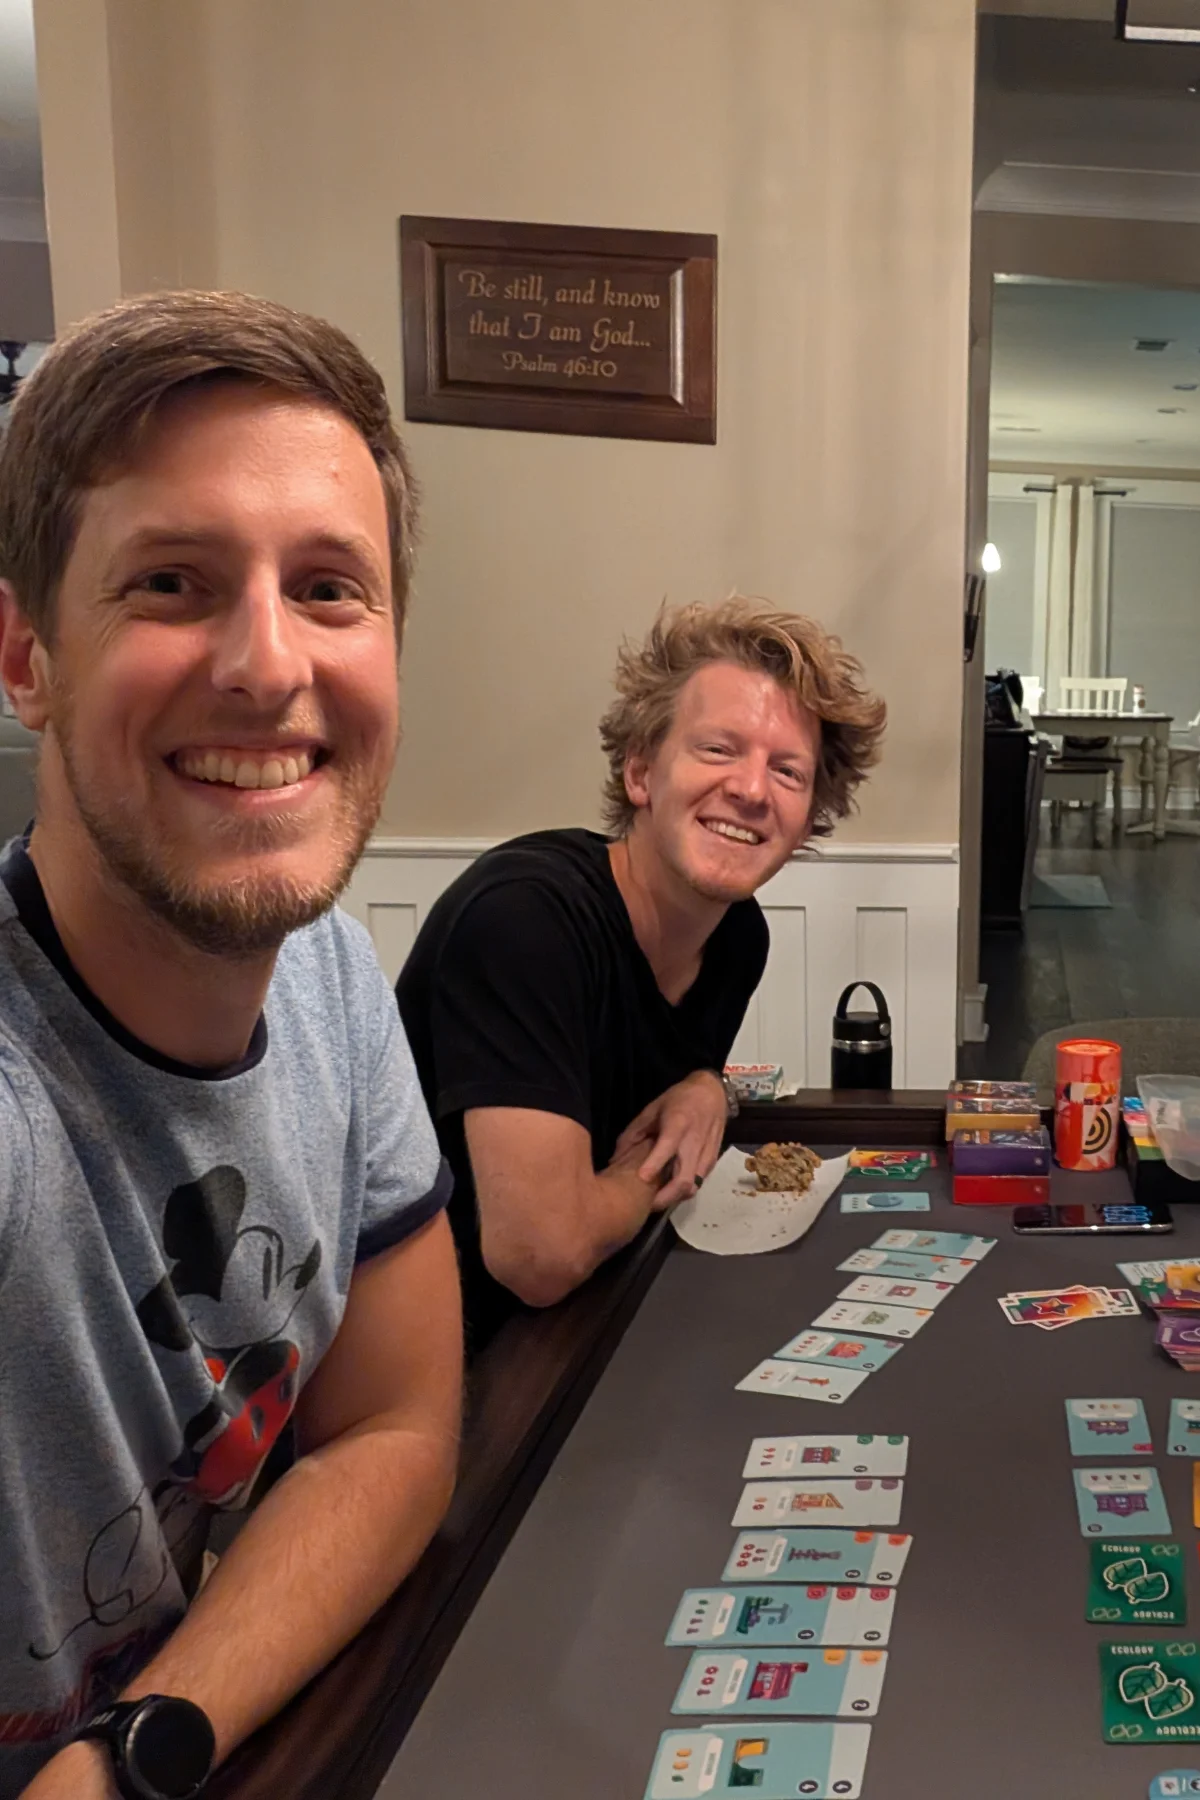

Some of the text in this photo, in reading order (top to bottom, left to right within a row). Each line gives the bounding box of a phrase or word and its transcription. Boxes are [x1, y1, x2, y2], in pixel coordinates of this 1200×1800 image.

[458, 269, 660, 309] Be still, and know
[469, 310, 510, 337] that
[517, 312, 543, 340] I
[549, 325, 582, 342] am
[502, 350, 617, 378] Psalm 46:10
[724, 1064, 776, 1073] ND-AID
[1110, 1645, 1154, 1655] ECOLOGY
